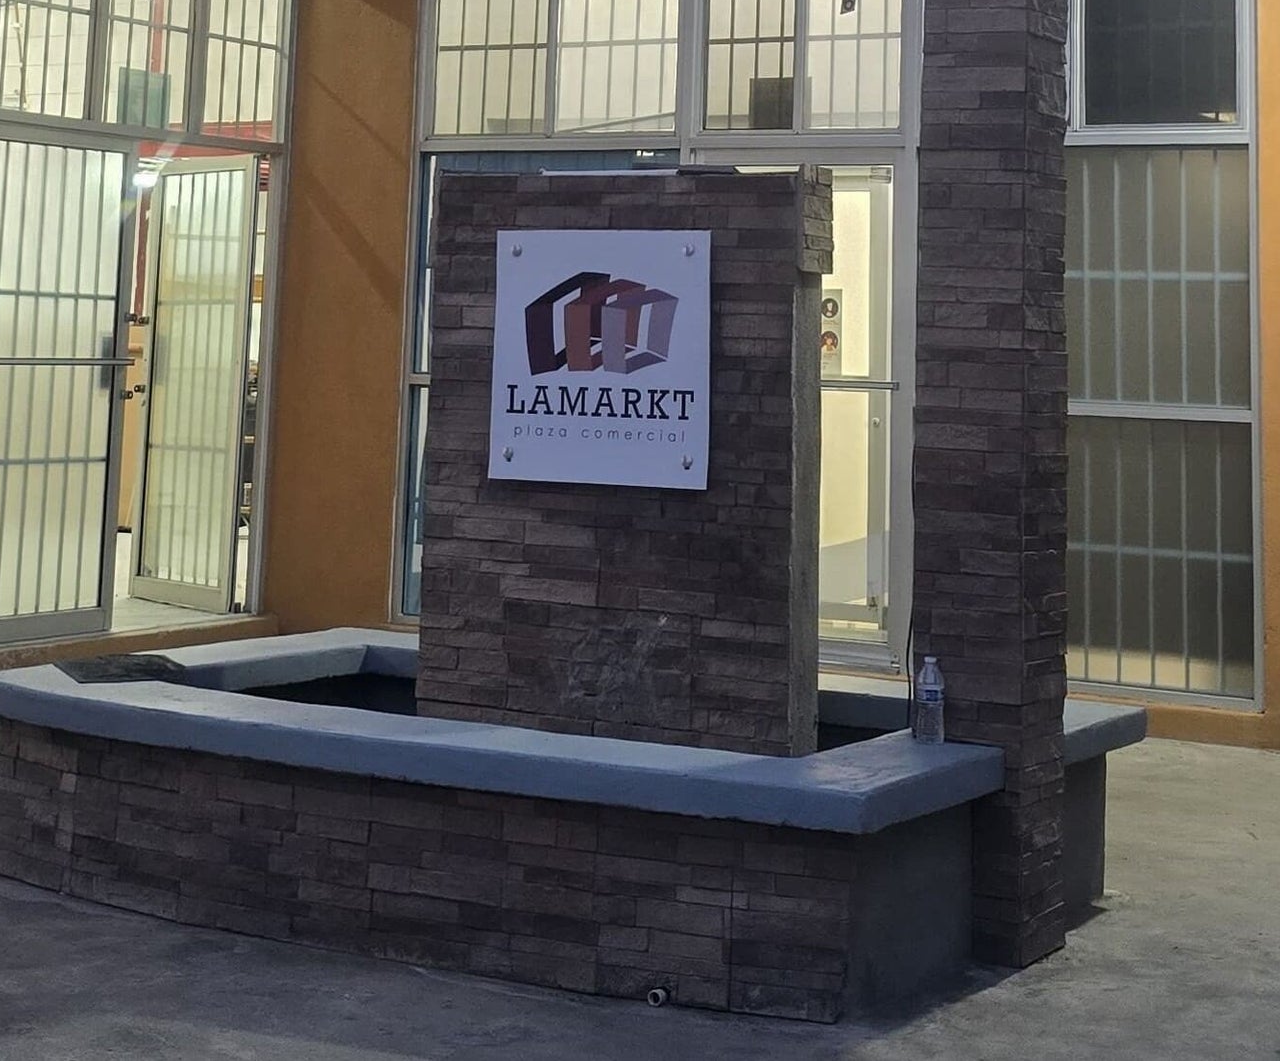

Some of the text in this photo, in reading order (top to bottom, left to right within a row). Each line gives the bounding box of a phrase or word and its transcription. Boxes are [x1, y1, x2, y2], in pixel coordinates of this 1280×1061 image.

[506, 384, 695, 421] LAMARKT
[513, 424, 686, 443] plaza comercial
